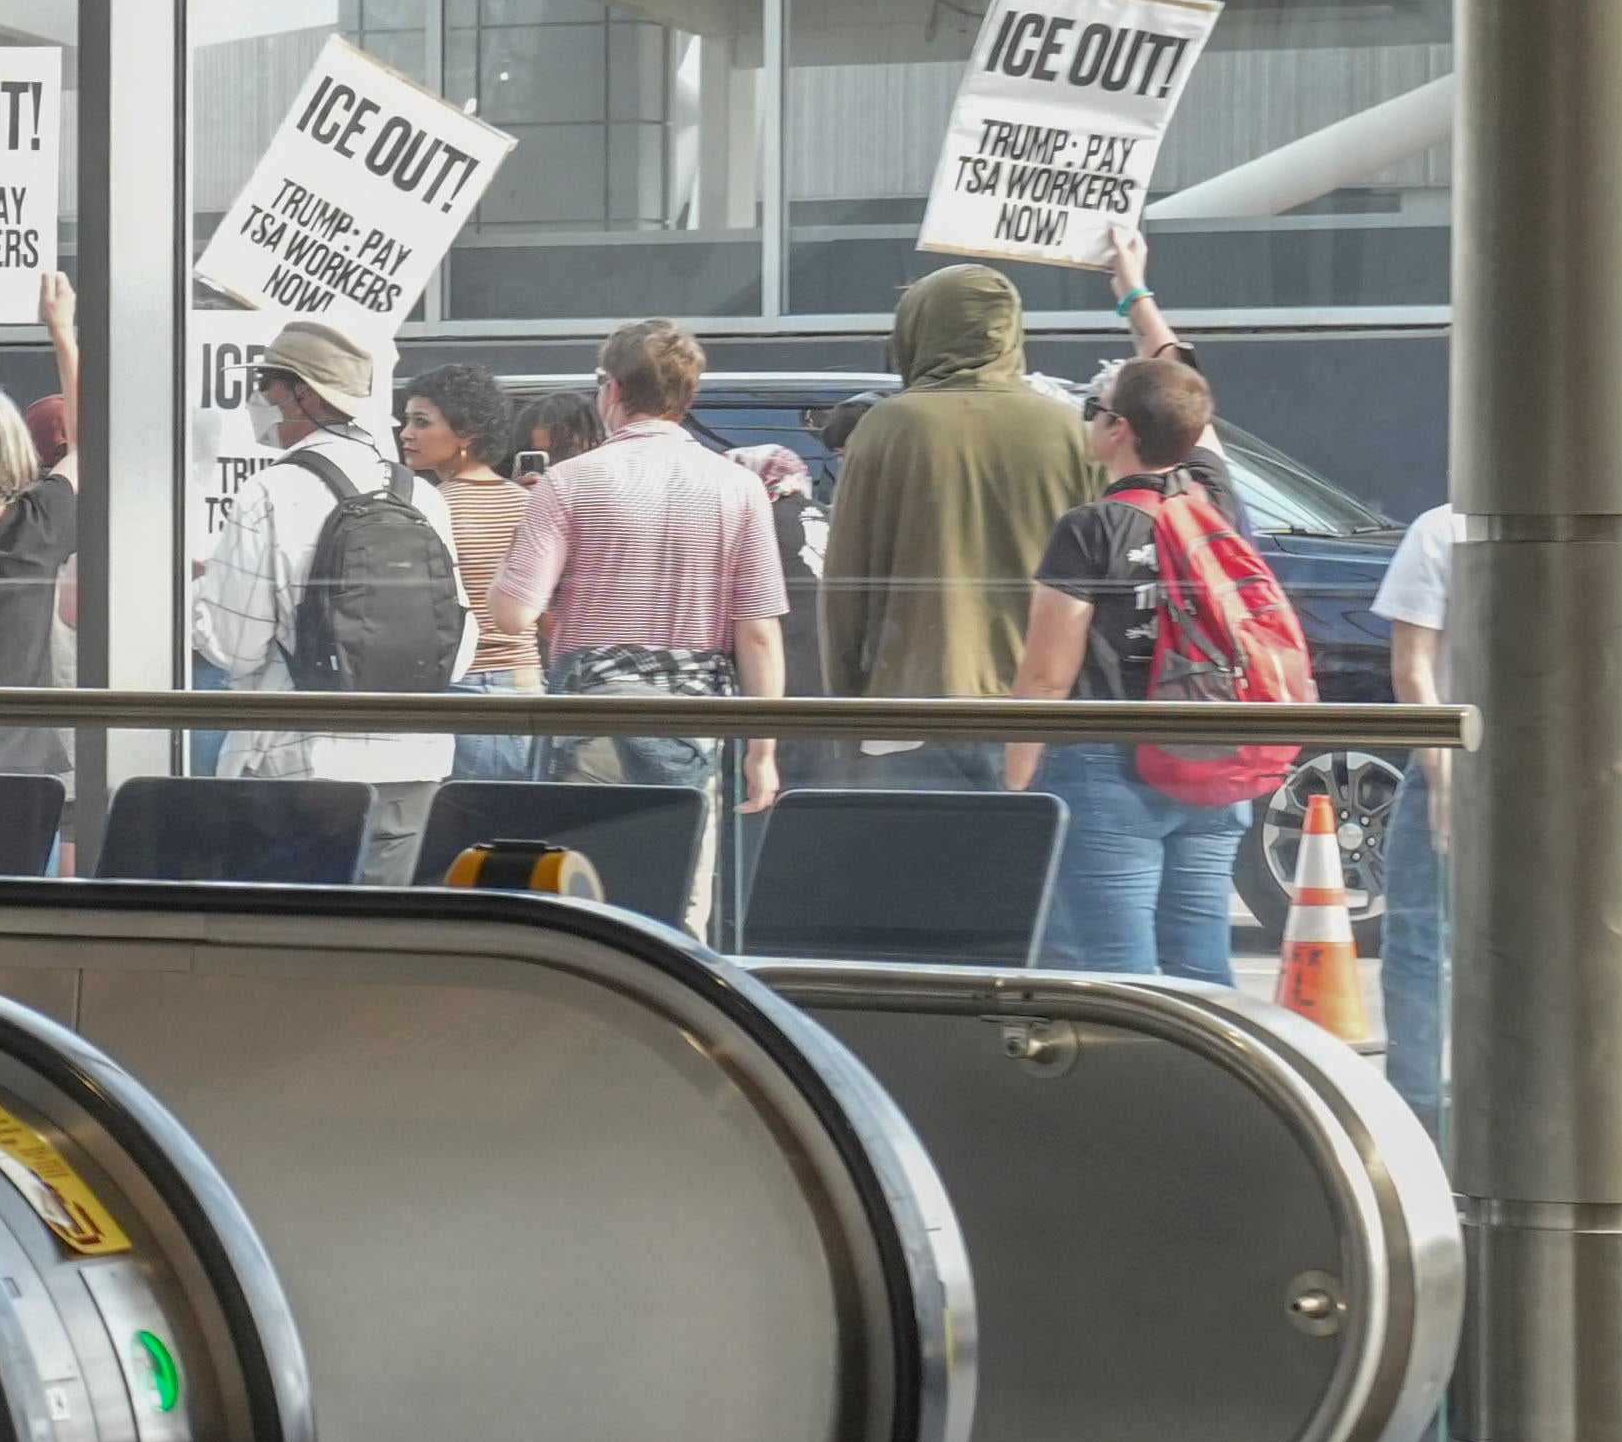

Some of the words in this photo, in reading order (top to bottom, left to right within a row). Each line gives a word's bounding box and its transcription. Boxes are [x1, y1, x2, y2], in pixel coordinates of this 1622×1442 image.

[984, 10, 1076, 82] ICE
[1068, 22, 1191, 99] OUT!
[296, 75, 382, 160] ICE
[364, 115, 481, 214] OUT!
[954, 155, 1003, 197] TSA
[1005, 162, 1136, 215] WORKERS
[977, 118, 1078, 169] TRUMP:
[1081, 133, 1138, 175] PAY
[239, 203, 288, 253] TSA
[283, 229, 403, 313] WORKERS
[270, 177, 361, 253] TRUMP:
[356, 227, 413, 277] PAY
[993, 202, 1069, 247] NOW!
